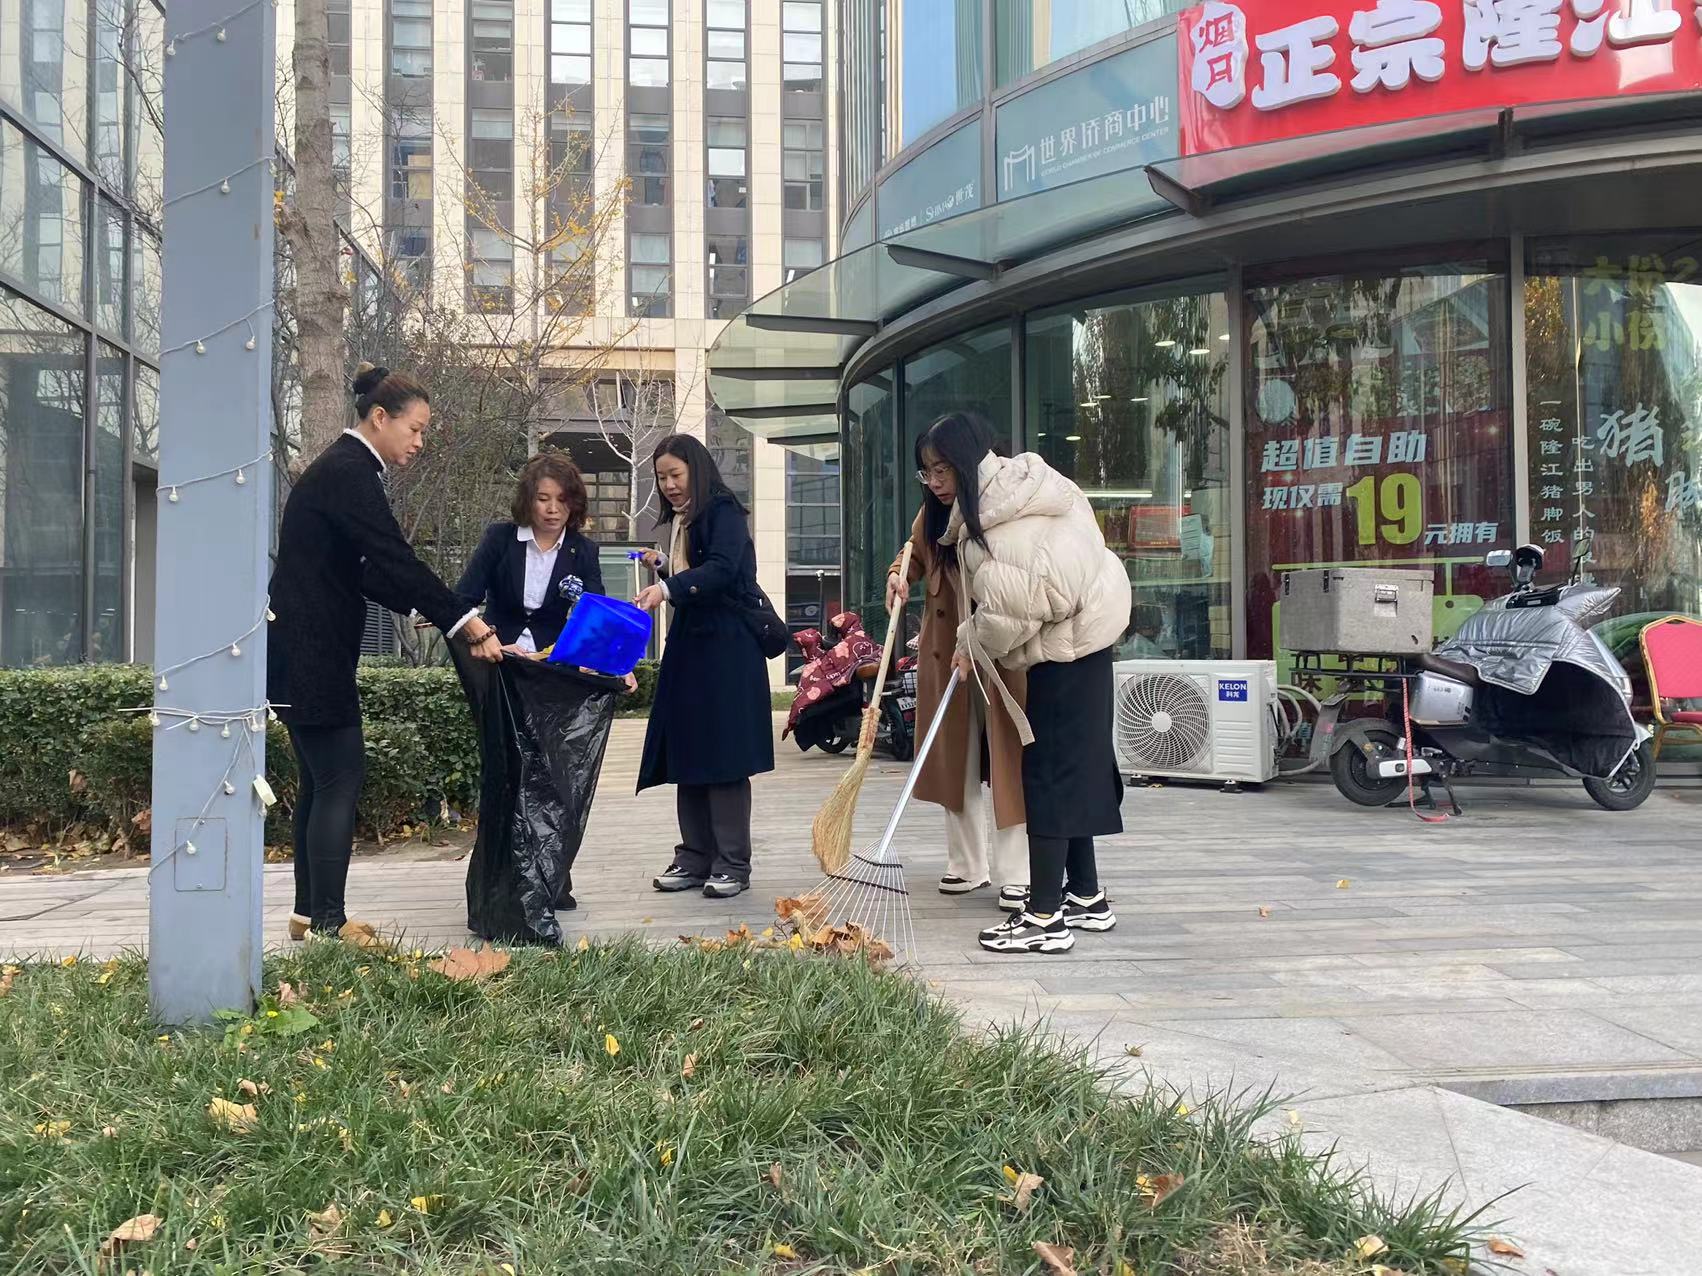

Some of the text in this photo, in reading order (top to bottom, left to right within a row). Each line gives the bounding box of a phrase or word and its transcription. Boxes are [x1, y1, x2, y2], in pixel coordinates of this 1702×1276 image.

[1040, 95, 1169, 165] 世界侨商中心
[1141, 126, 1169, 142] CENTER
[1260, 429, 1427, 473] 超值自助
[1539, 399, 1565, 544] 一碗隆江猪脚饭
[1219, 683, 1247, 691] KELON
